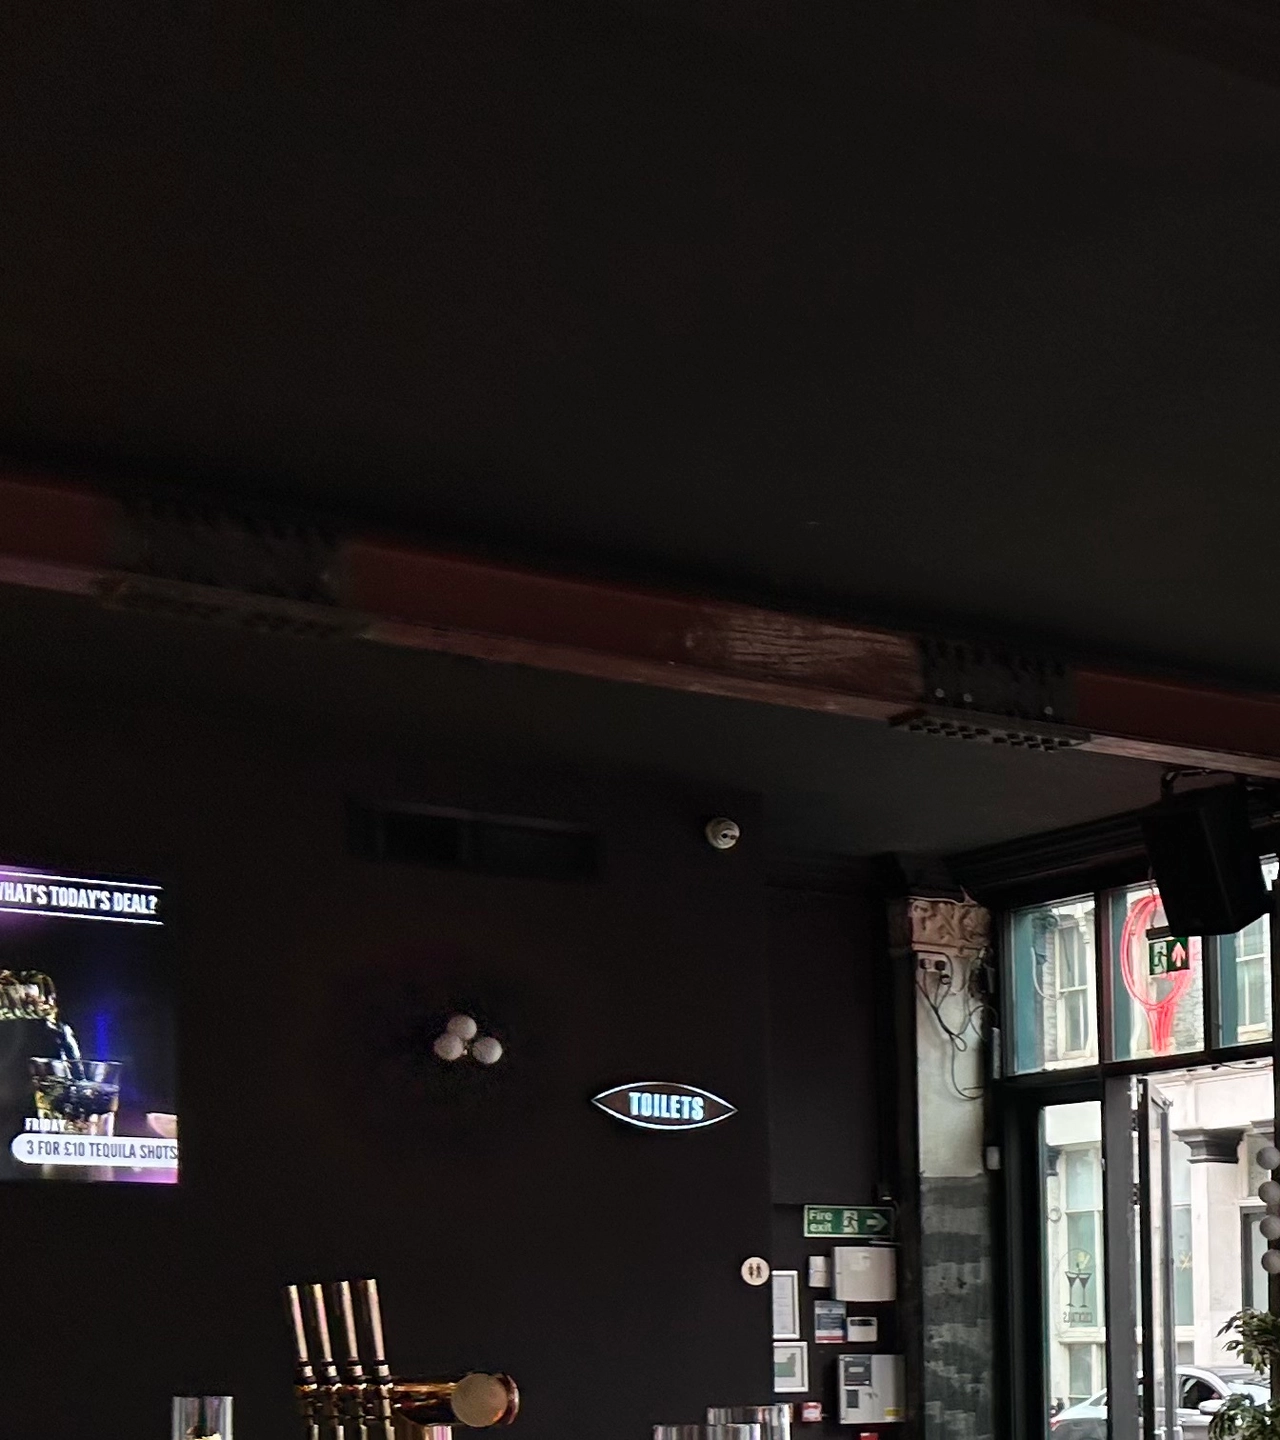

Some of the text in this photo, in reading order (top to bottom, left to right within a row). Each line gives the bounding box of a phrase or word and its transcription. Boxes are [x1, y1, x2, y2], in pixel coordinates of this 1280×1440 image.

[50, 886, 111, 911] TODAY'S
[112, 891, 158, 914] DEAL?
[628, 1091, 704, 1121] TOILETS
[25, 1117, 66, 1132] FRIDAY
[26, 1140, 178, 1161] 3 FOR £10 TEQUILA SHOTS
[808, 1209, 833, 1222] Fire
[808, 1222, 833, 1234] exit
